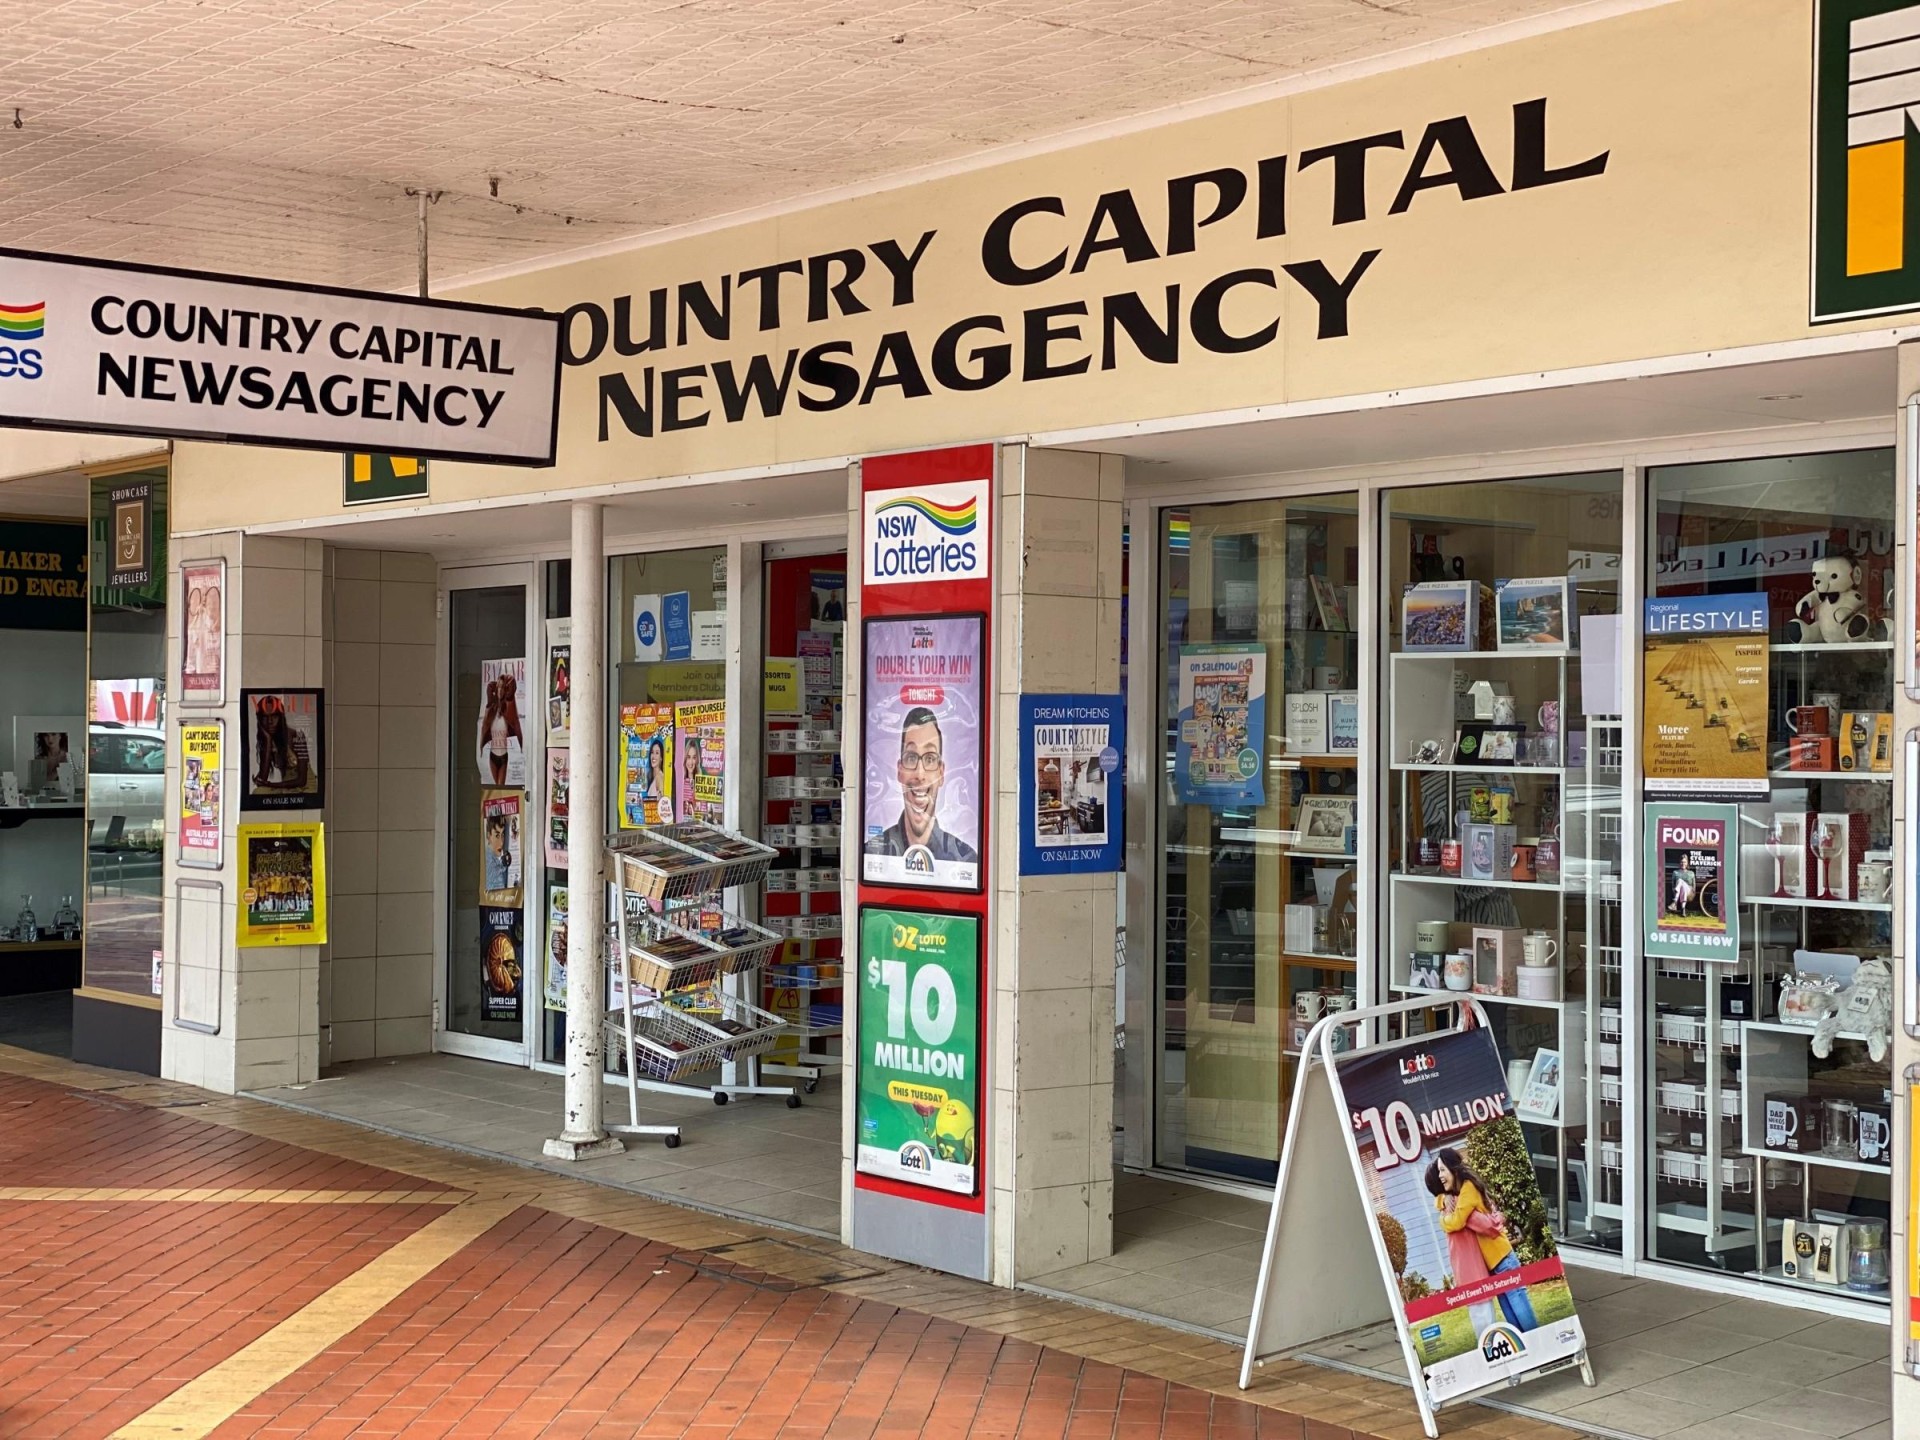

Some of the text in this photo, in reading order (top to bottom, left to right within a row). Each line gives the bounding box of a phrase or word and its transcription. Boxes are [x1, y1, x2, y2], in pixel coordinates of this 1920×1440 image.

[557, 97, 1611, 367] OUNTRY CAPITAL
[90, 295, 322, 355] COUNTRY
[330, 321, 516, 376] CAPITAL
[599, 248, 1382, 443] NEWSAGENCY
[97, 352, 506, 429] NEWSAGENCY
[111, 485, 149, 501] SHOWCASE
[877, 514, 918, 539] NSW
[874, 536, 977, 577] Lotteries
[111, 571, 148, 586] JEWELLERS
[1650, 603, 1679, 614] Regional
[1650, 610, 1763, 632] LIFESTYLE
[911, 636, 934, 649] Lotto
[876, 654, 972, 675] DOUBLE YOUR WIN
[683, 670, 721, 680] Join our
[764, 671, 791, 680] SSORTED
[652, 682, 721, 692] Members Club
[768, 684, 786, 692] MUGS
[908, 688, 936, 701] TONIGHT
[678, 701, 726, 717] TREAT YOURSELF
[1034, 707, 1110, 719] DREAM KITCHENS
[1291, 702, 1319, 713] SPLOSH
[679, 717, 693, 727] YOU
[693, 714, 719, 725] DESERVE
[1658, 724, 1689, 735] Moree
[189, 742, 200, 752] BUY
[1662, 827, 1720, 844] FOUND
[1041, 849, 1102, 862] ON SALE NOW
[905, 857, 925, 872] Lott
[625, 895, 647, 913] ome
[893, 924, 947, 951] OZ LOTTO
[1650, 931, 1734, 947] ON SALE NOW
[488, 996, 517, 1005] SUPPER CLUB
[868, 956, 957, 1046] $10
[874, 1041, 965, 1081] MILLION
[1399, 1053, 1436, 1076] Lotto
[893, 1086, 943, 1104] THIS TUESDAY
[1769, 1109, 1784, 1117] DAD
[1351, 1100, 1423, 1171] $10
[900, 1152, 921, 1169] Lott
[1796, 1241, 1812, 1252] 21
[1445, 1273, 1522, 1306] Special Event This Saturday!
[1482, 1339, 1512, 1363] Lott
